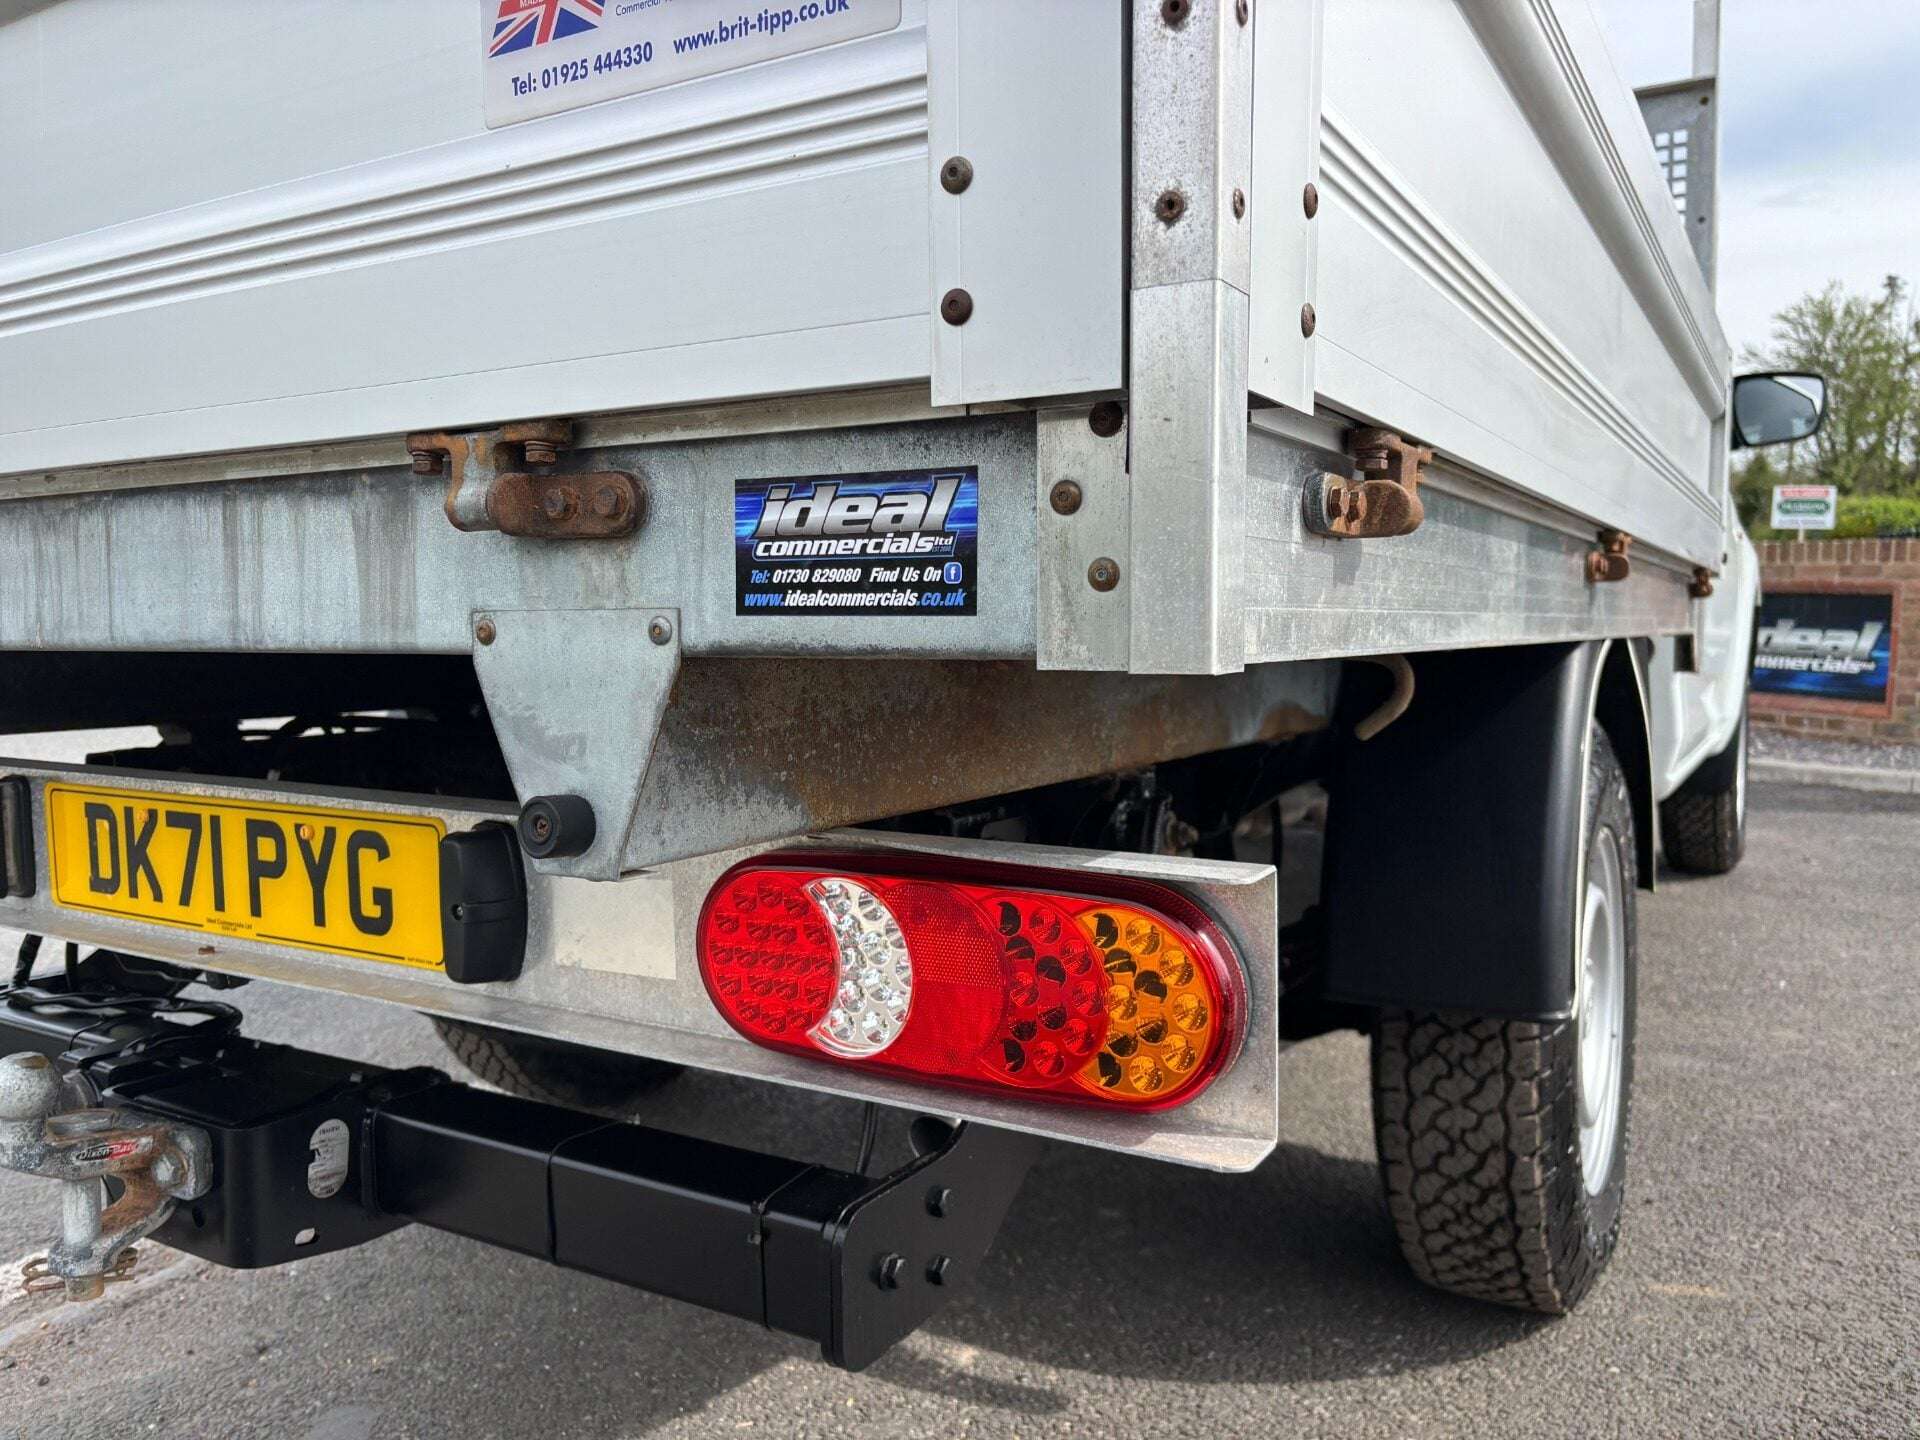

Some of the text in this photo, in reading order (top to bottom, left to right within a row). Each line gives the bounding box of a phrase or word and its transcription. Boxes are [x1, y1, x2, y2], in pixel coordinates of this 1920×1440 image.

[511, 41, 653, 96] Tel: 01925 444330
[756, 479, 959, 536] ideal
[756, 532, 934, 557] commercials
[751, 569, 770, 583] Tel:
[772, 568, 810, 583] 01730
[811, 568, 862, 583] 829080
[869, 567, 900, 582] Find
[902, 566, 921, 582] Us
[922, 566, 942, 582] On
[744, 589, 967, 607] www.idealcommercials.co.uk
[1757, 618, 1883, 659] deal
